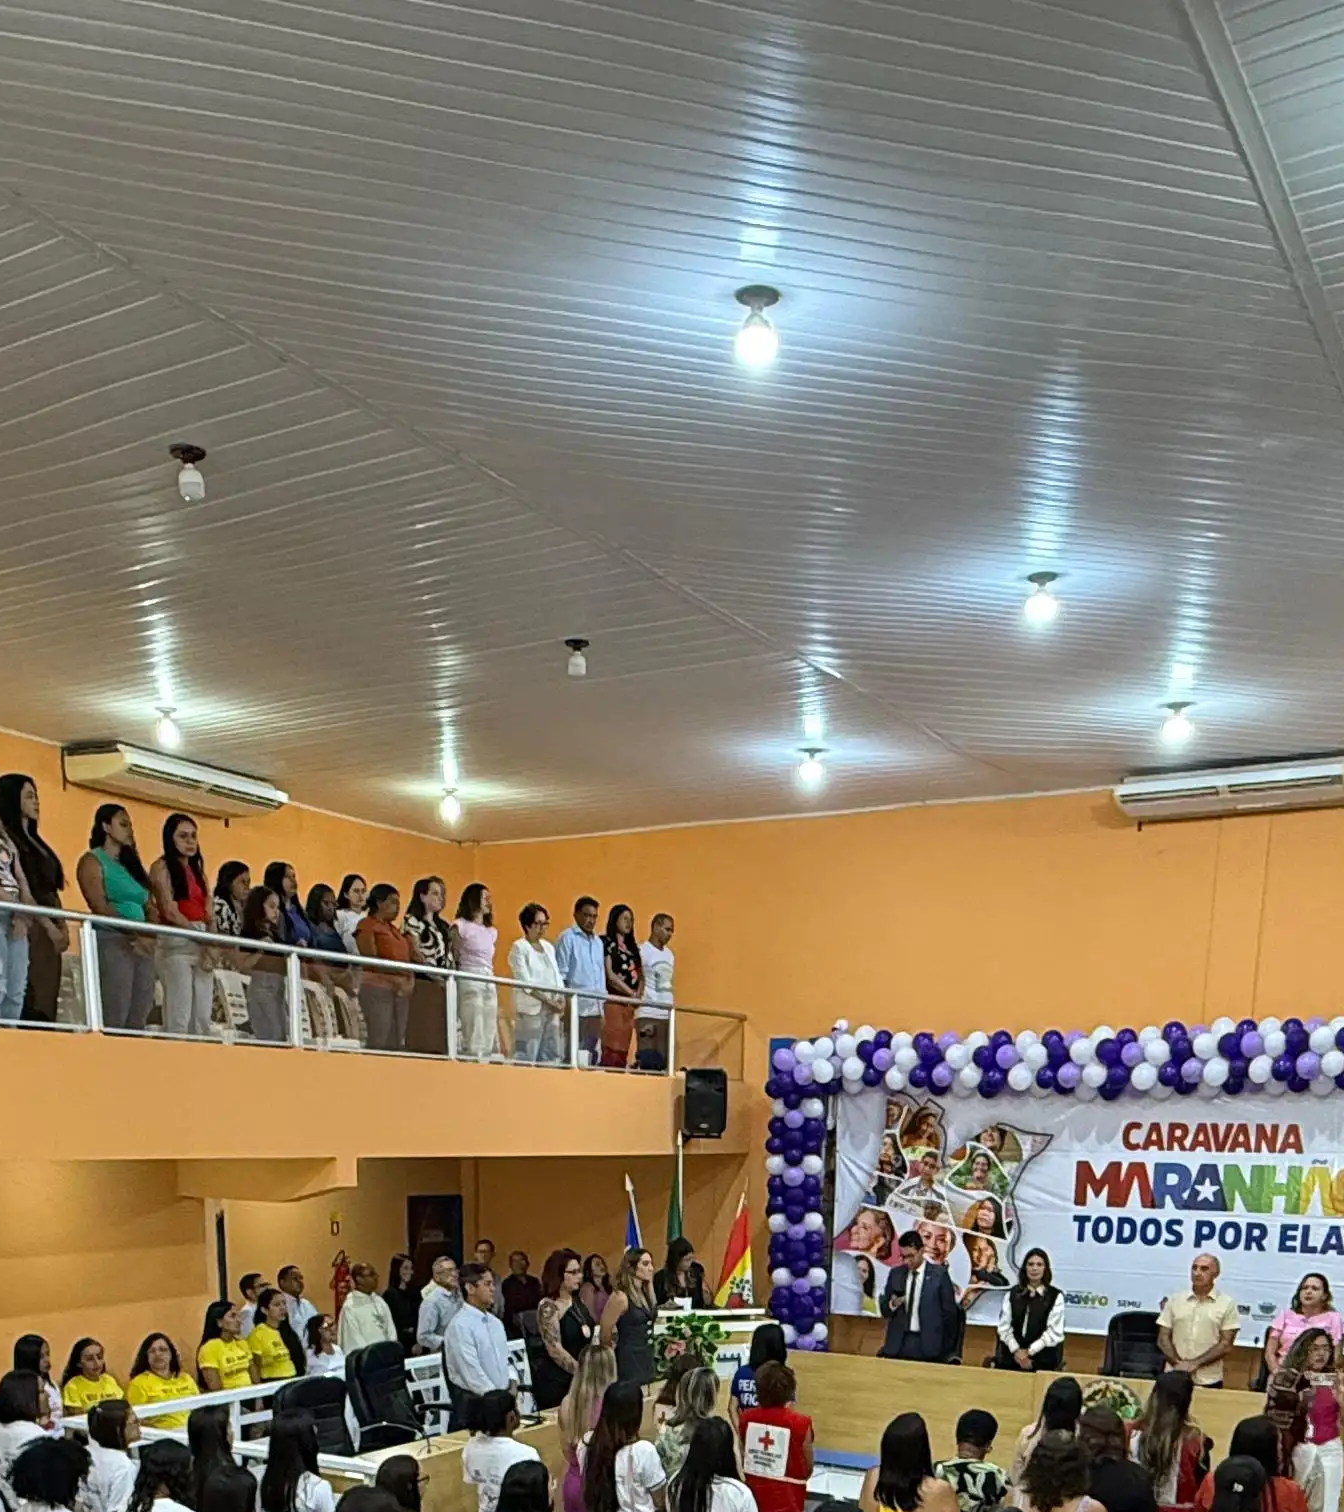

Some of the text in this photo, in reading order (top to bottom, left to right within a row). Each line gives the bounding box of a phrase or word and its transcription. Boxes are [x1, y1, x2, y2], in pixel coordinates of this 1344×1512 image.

[1122, 1121, 1304, 1155] CARAVANA
[1072, 1215, 1184, 1248] TODOS
[1194, 1220, 1267, 1252] POR
